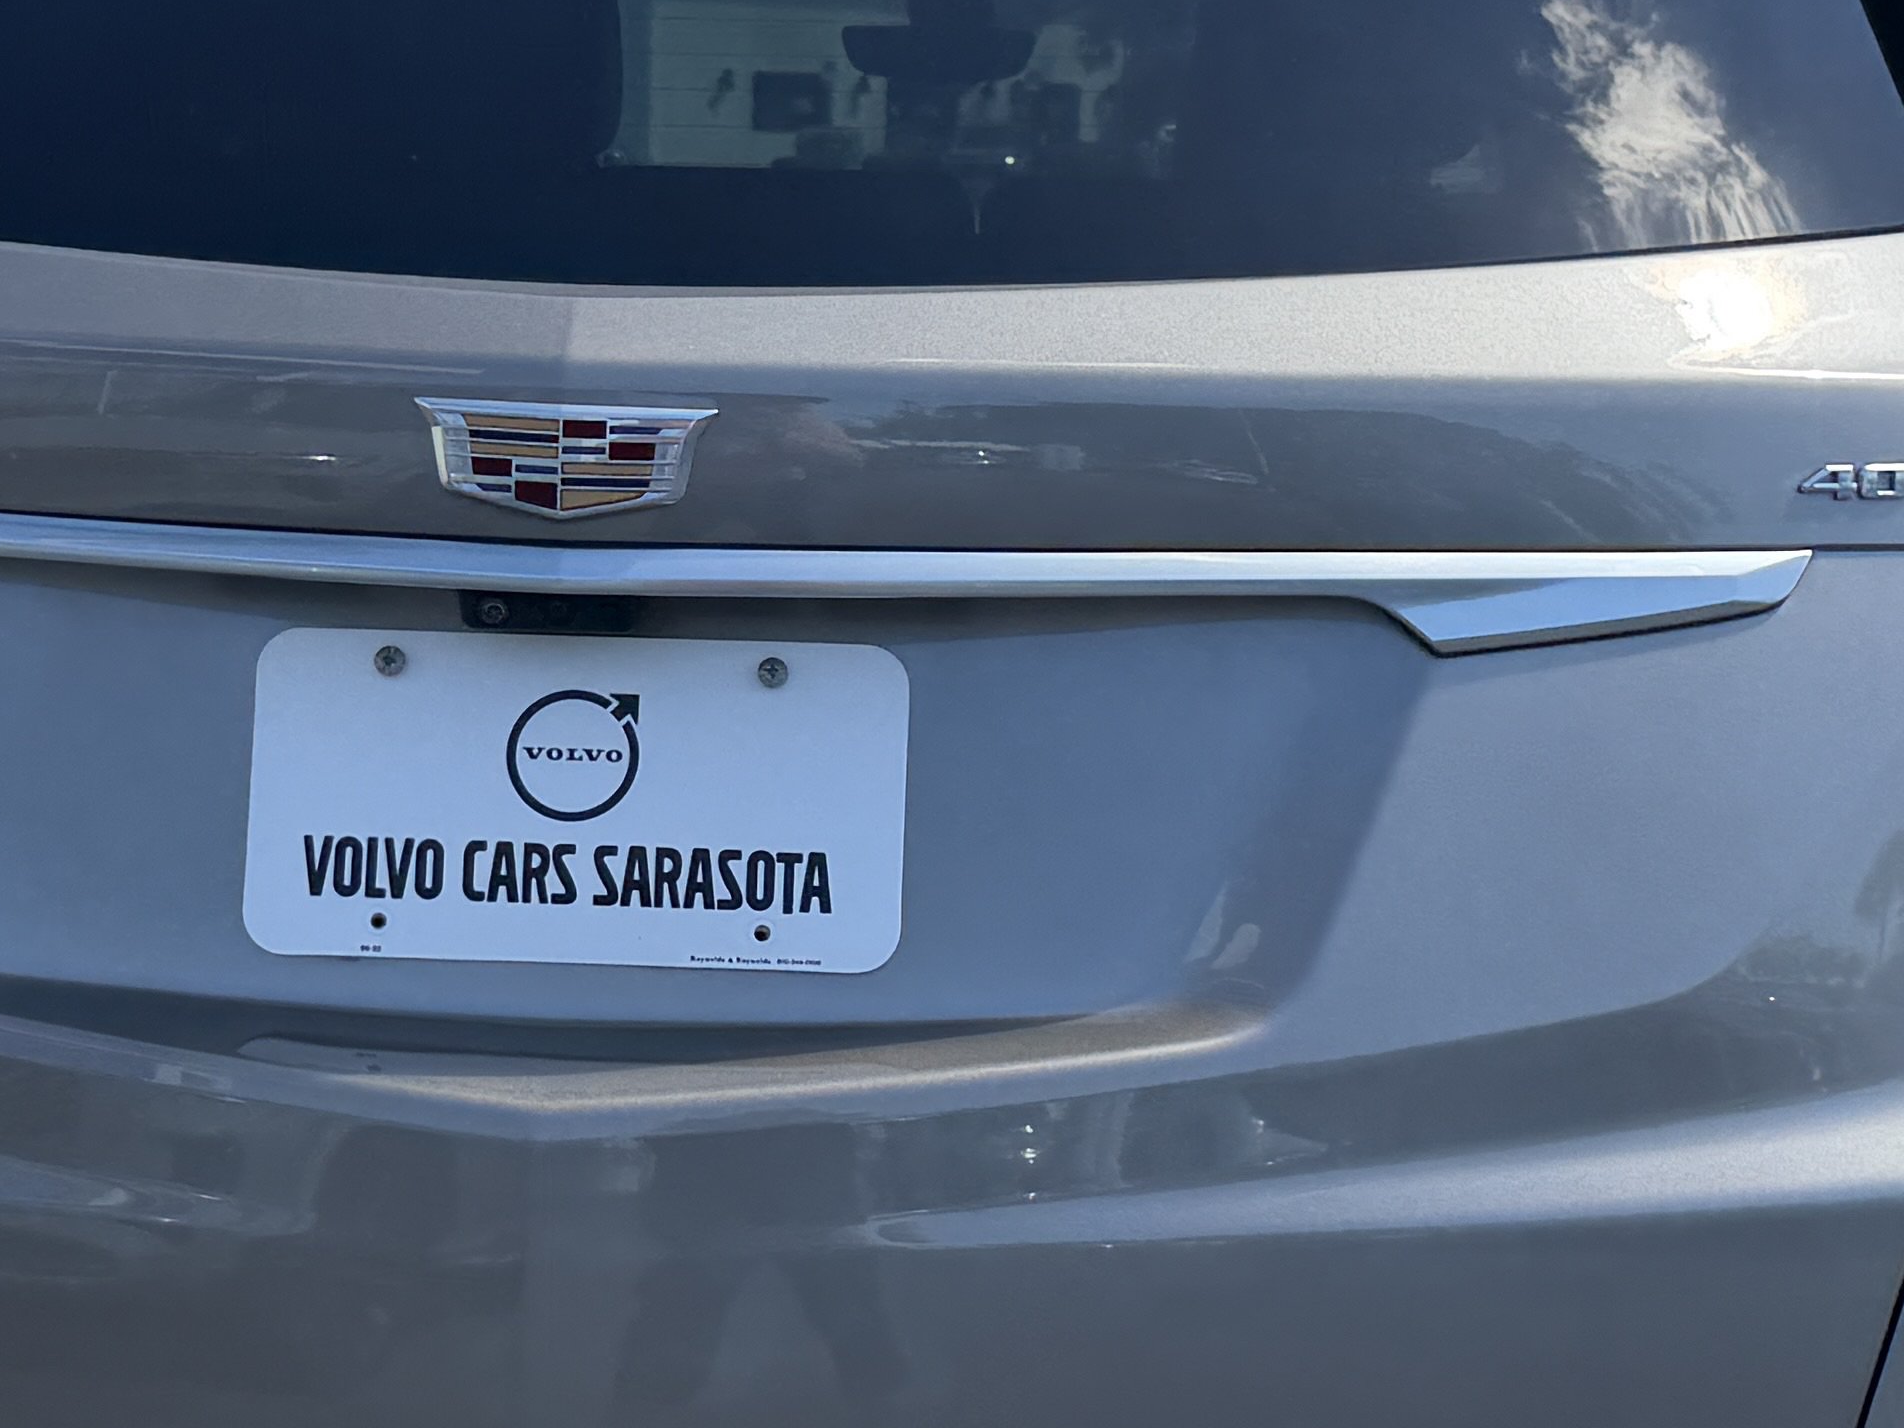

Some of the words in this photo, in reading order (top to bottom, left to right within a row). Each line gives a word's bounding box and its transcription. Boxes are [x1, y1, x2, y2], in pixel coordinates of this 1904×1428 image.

[523, 747, 622, 762] VOLVO
[304, 835, 444, 900] VOLVO
[462, 840, 577, 904] CARS
[593, 845, 831, 914] SARASOTA
